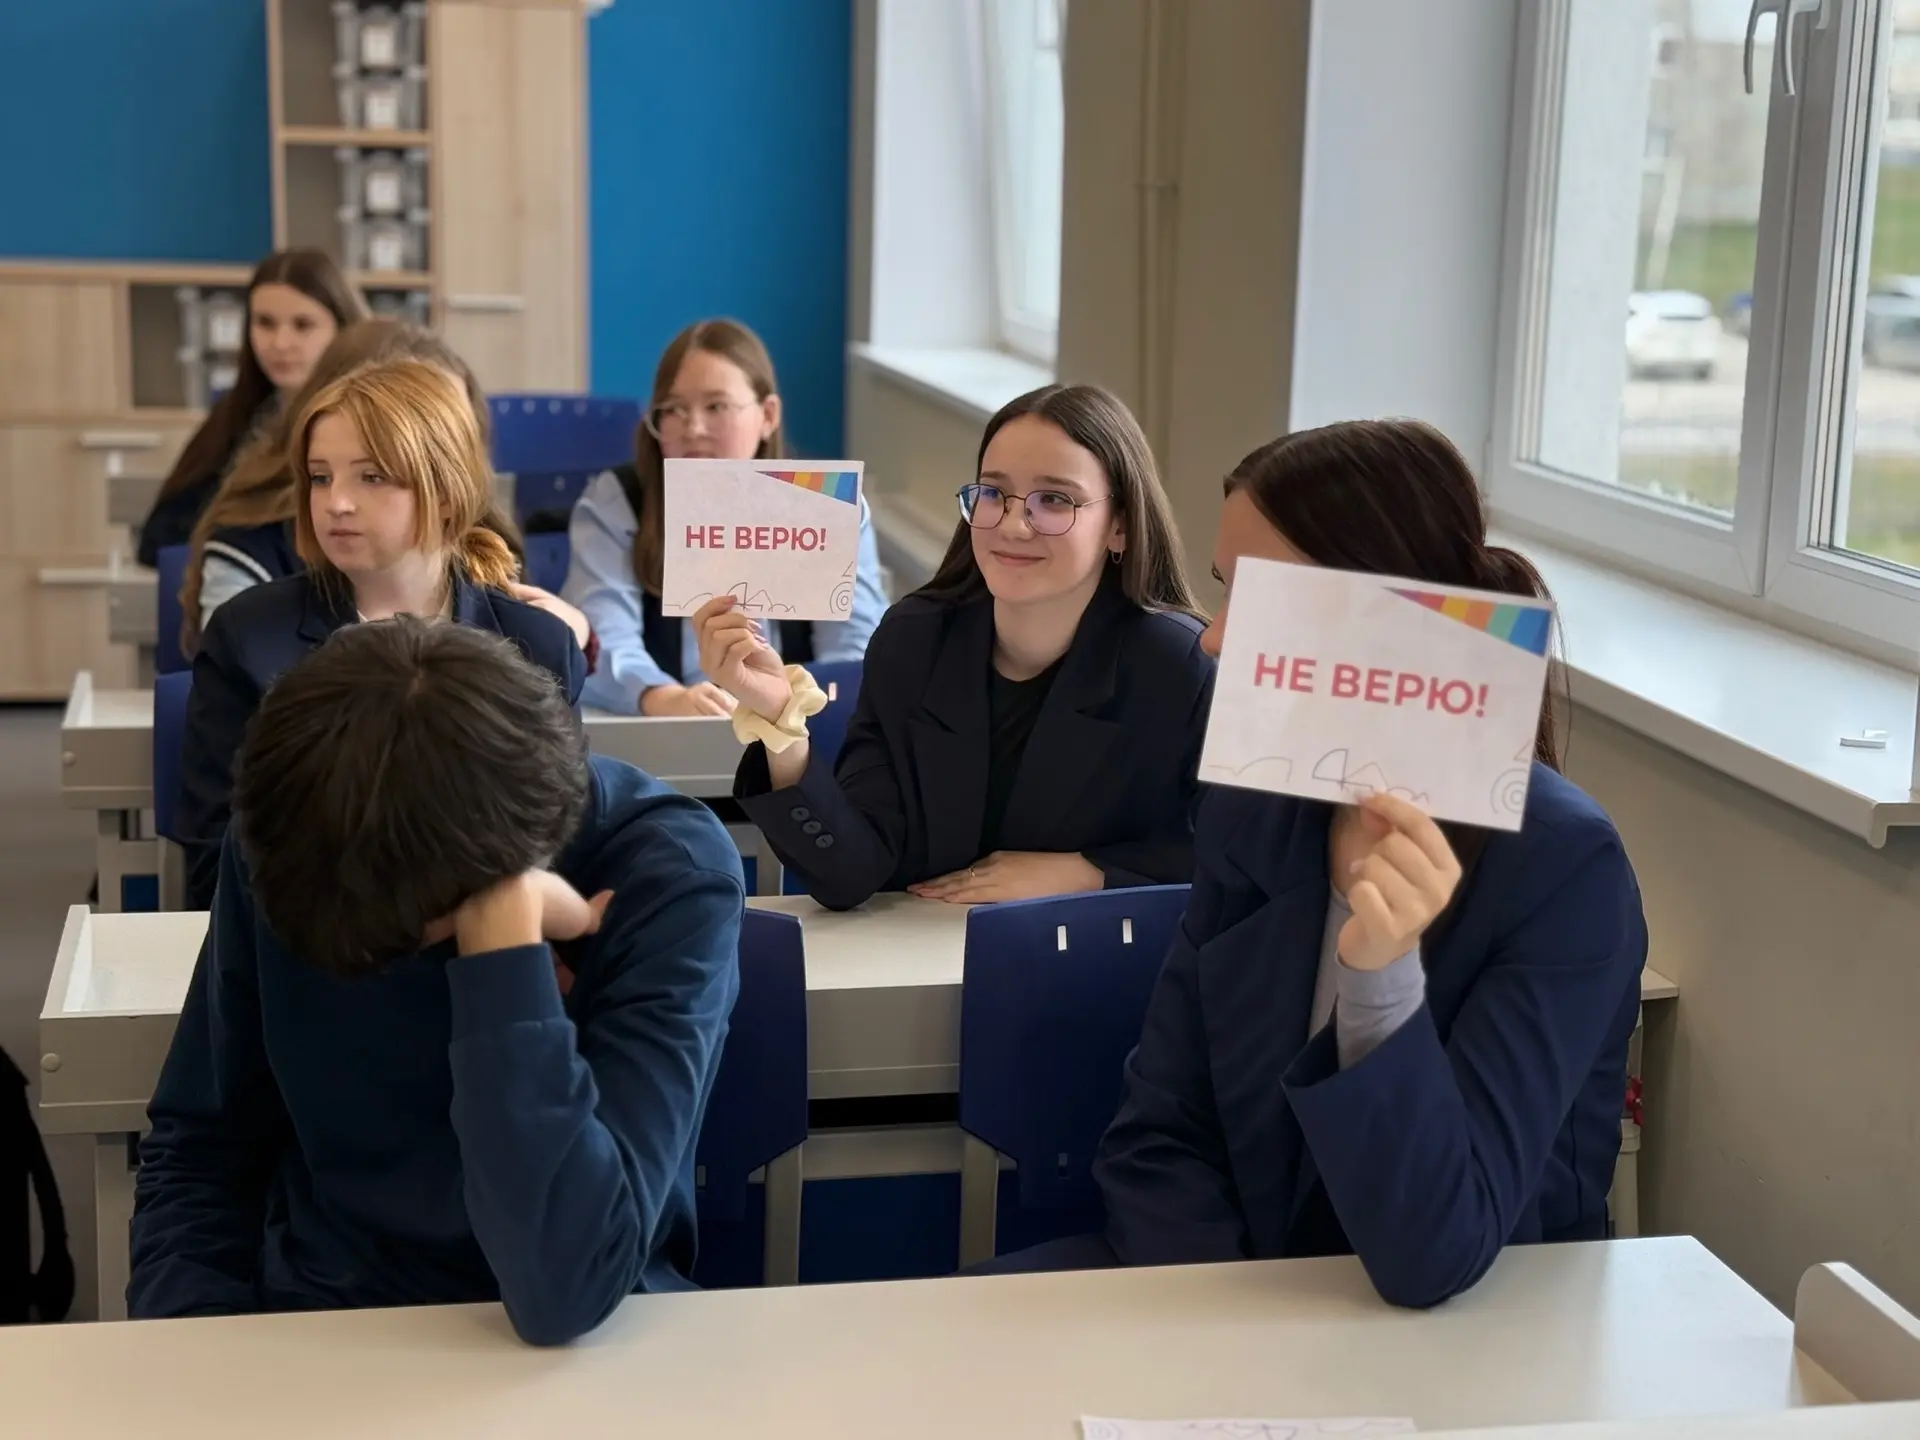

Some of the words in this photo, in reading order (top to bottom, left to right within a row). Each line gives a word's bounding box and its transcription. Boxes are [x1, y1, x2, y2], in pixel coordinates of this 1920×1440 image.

[685, 525, 725, 549] НЕ
[735, 526, 827, 551] ВЕРЮ!
[1254, 653, 1317, 693] НЕ
[1331, 663, 1489, 718] ВЕРЮ!
